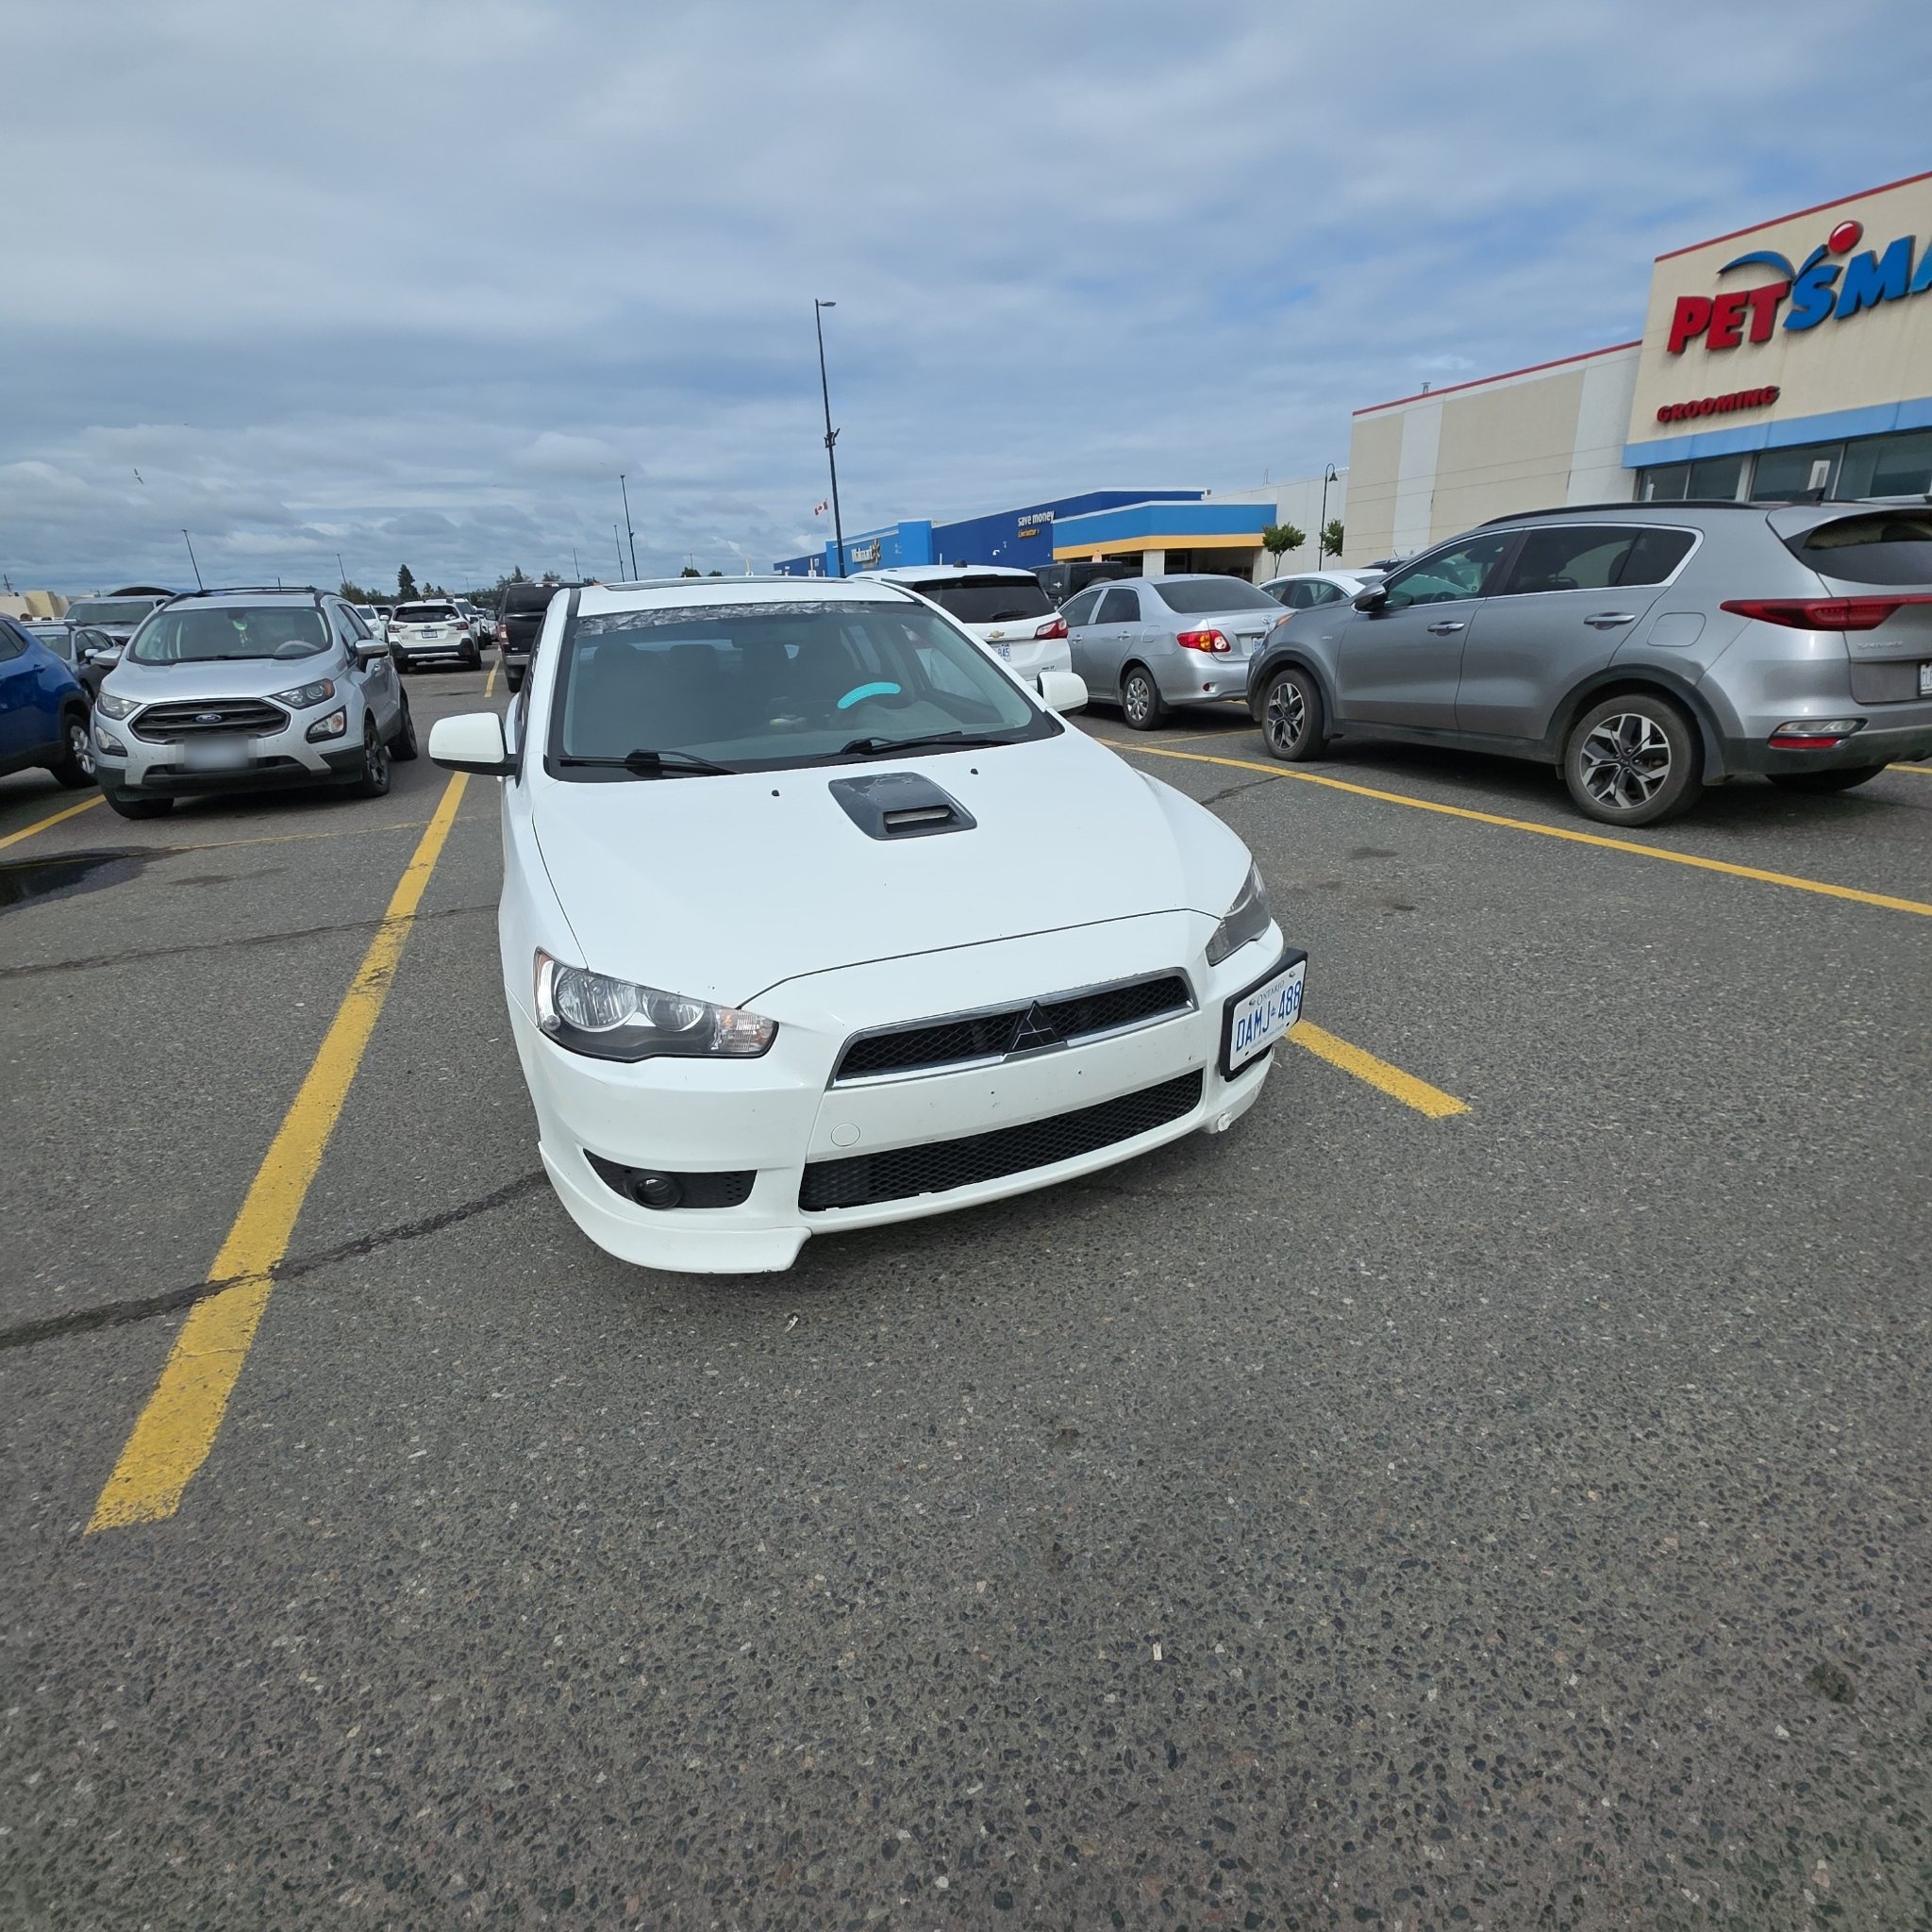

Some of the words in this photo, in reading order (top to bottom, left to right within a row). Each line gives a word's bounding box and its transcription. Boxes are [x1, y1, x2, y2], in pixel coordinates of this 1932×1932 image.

[1657, 386, 1780, 423] GROOMING
[1018, 515, 1031, 527] save
[1032, 510, 1055, 525] money
[1257, 980, 1285, 1007] ONTARIO
